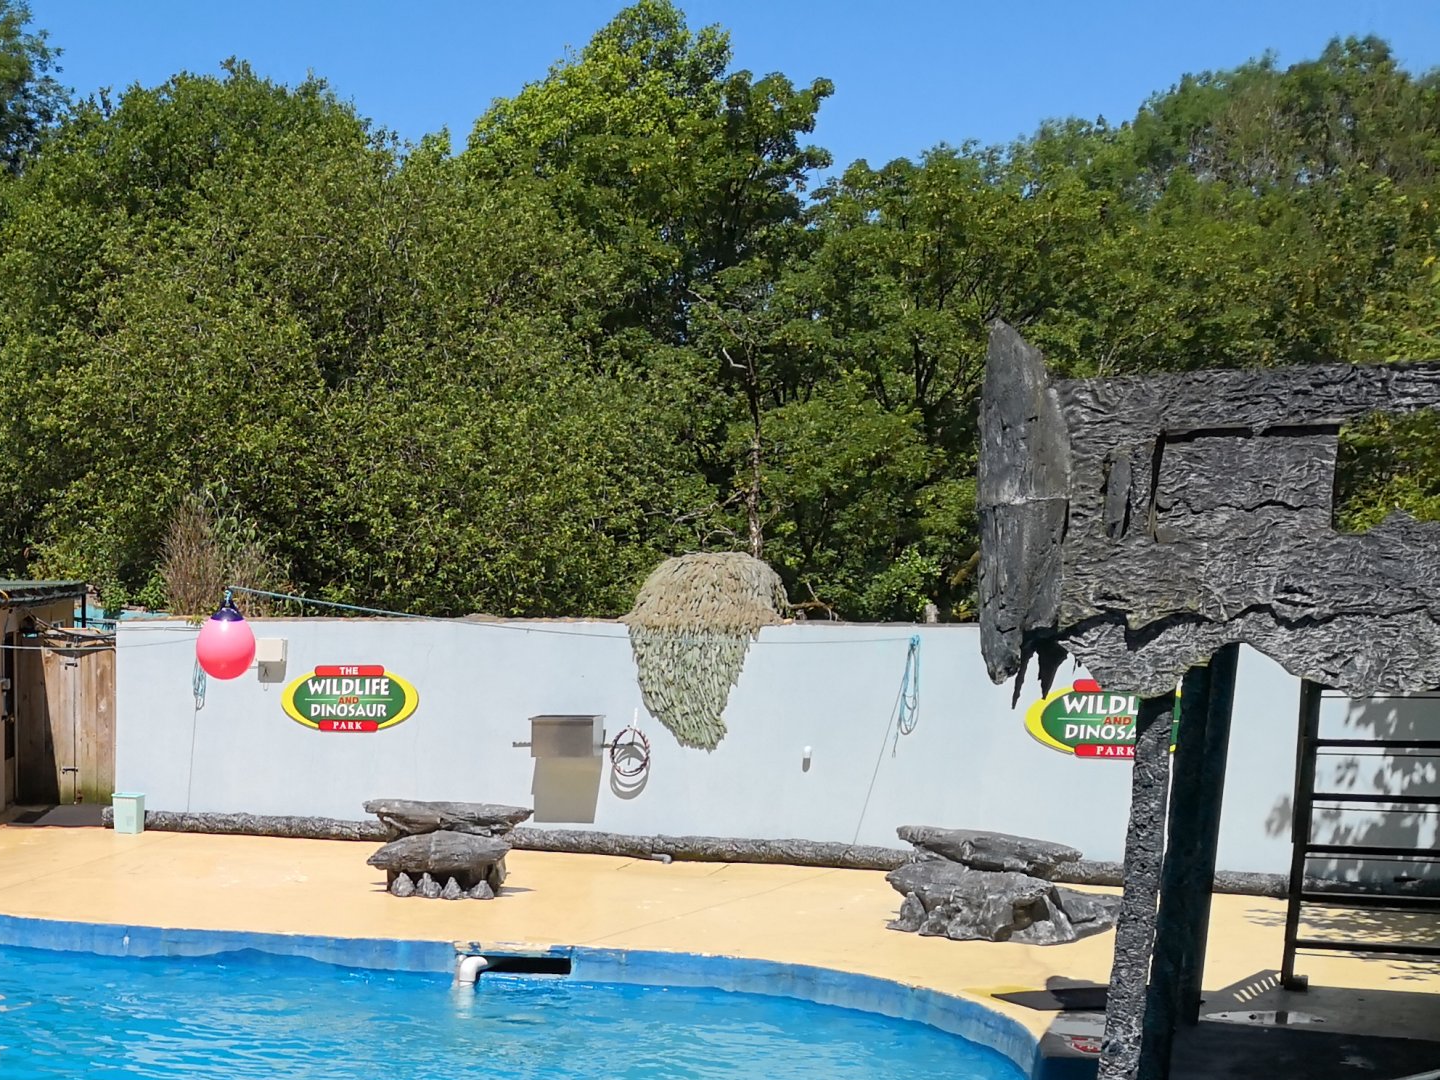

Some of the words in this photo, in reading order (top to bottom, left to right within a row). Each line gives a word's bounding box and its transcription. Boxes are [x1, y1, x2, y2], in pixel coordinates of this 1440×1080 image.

[339, 667, 359, 675] THE
[307, 678, 390, 695] WILDLIFE
[338, 696, 359, 704] AND
[1062, 694, 1139, 715] WILDL
[310, 703, 387, 717] DINOSAUR
[333, 721, 362, 730] PARK
[1103, 716, 1132, 725] AND
[1064, 723, 1136, 740] DINOSA
[1095, 745, 1135, 756] PARK
